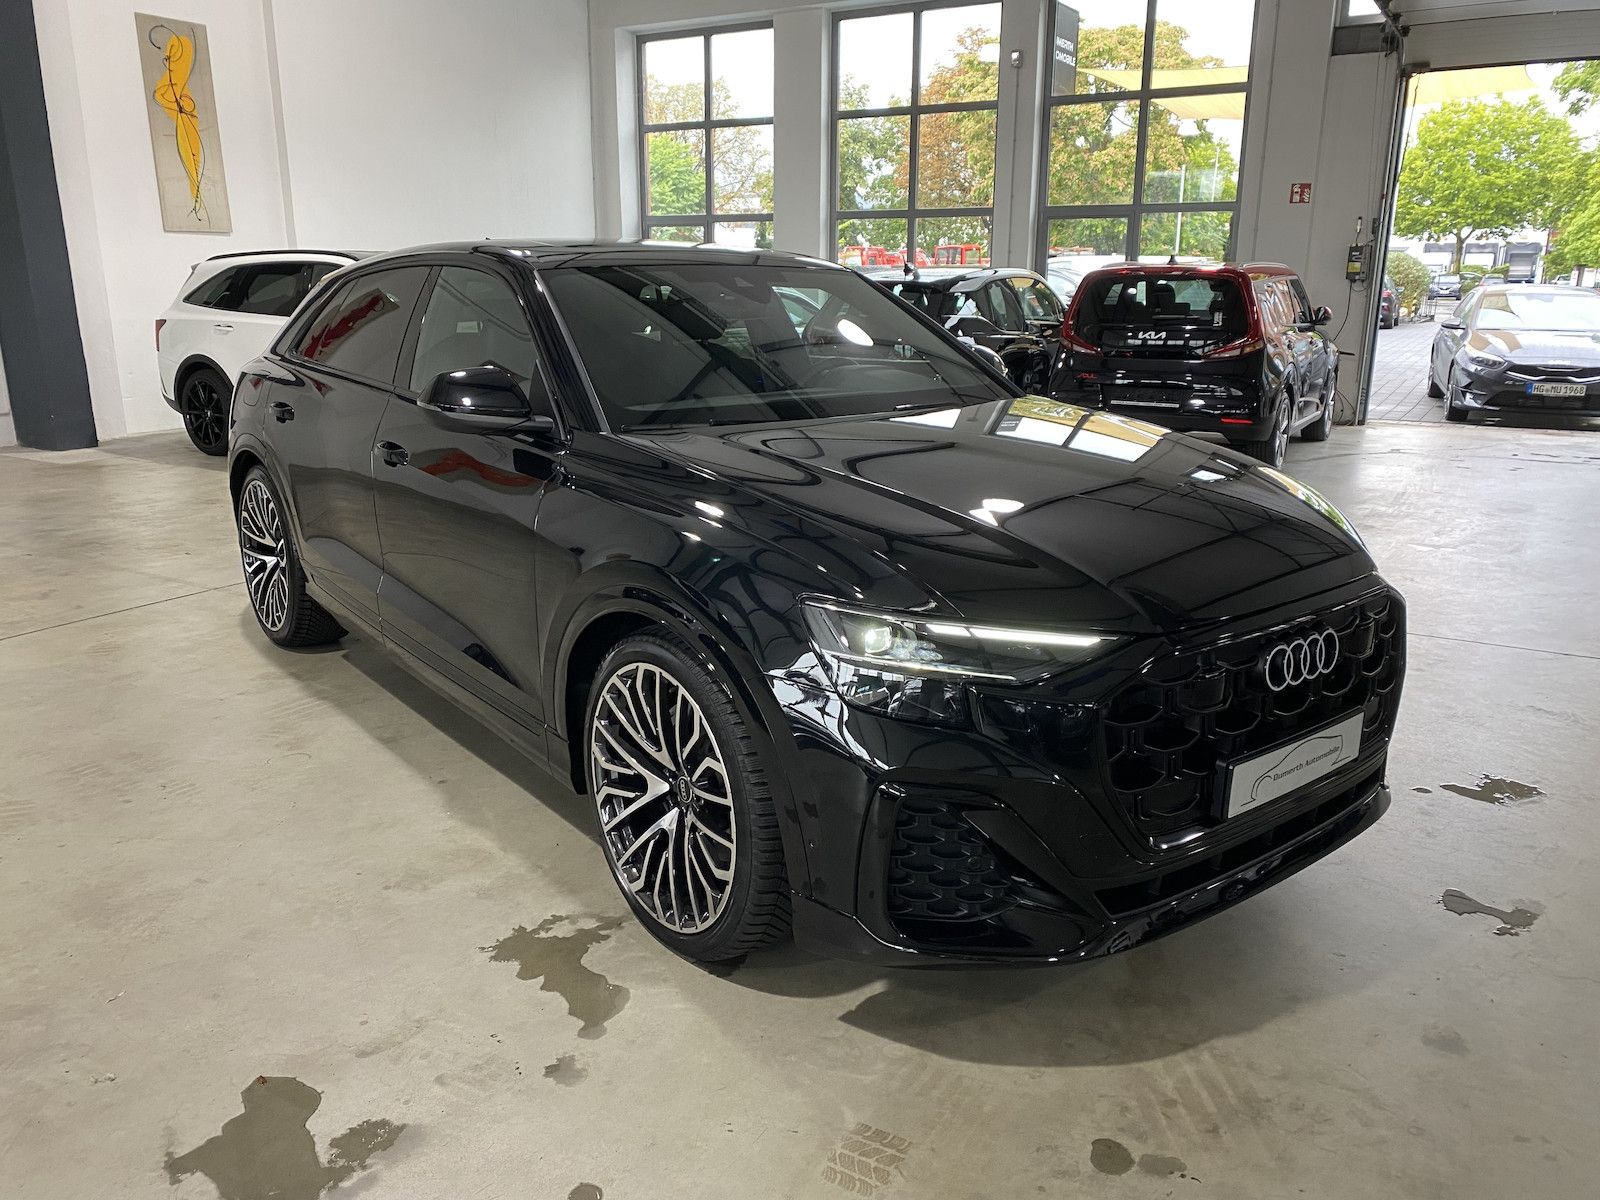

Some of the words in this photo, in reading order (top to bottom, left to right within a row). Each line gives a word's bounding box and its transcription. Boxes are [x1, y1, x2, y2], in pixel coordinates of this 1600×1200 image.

[1138, 331, 1167, 340] KIA
[1533, 384, 1545, 393] HG
[1550, 385, 1562, 393] MU
[1564, 385, 1585, 395] 1968
[1273, 763, 1304, 781] Dumerth
[1304, 746, 1340, 767] Automobile
